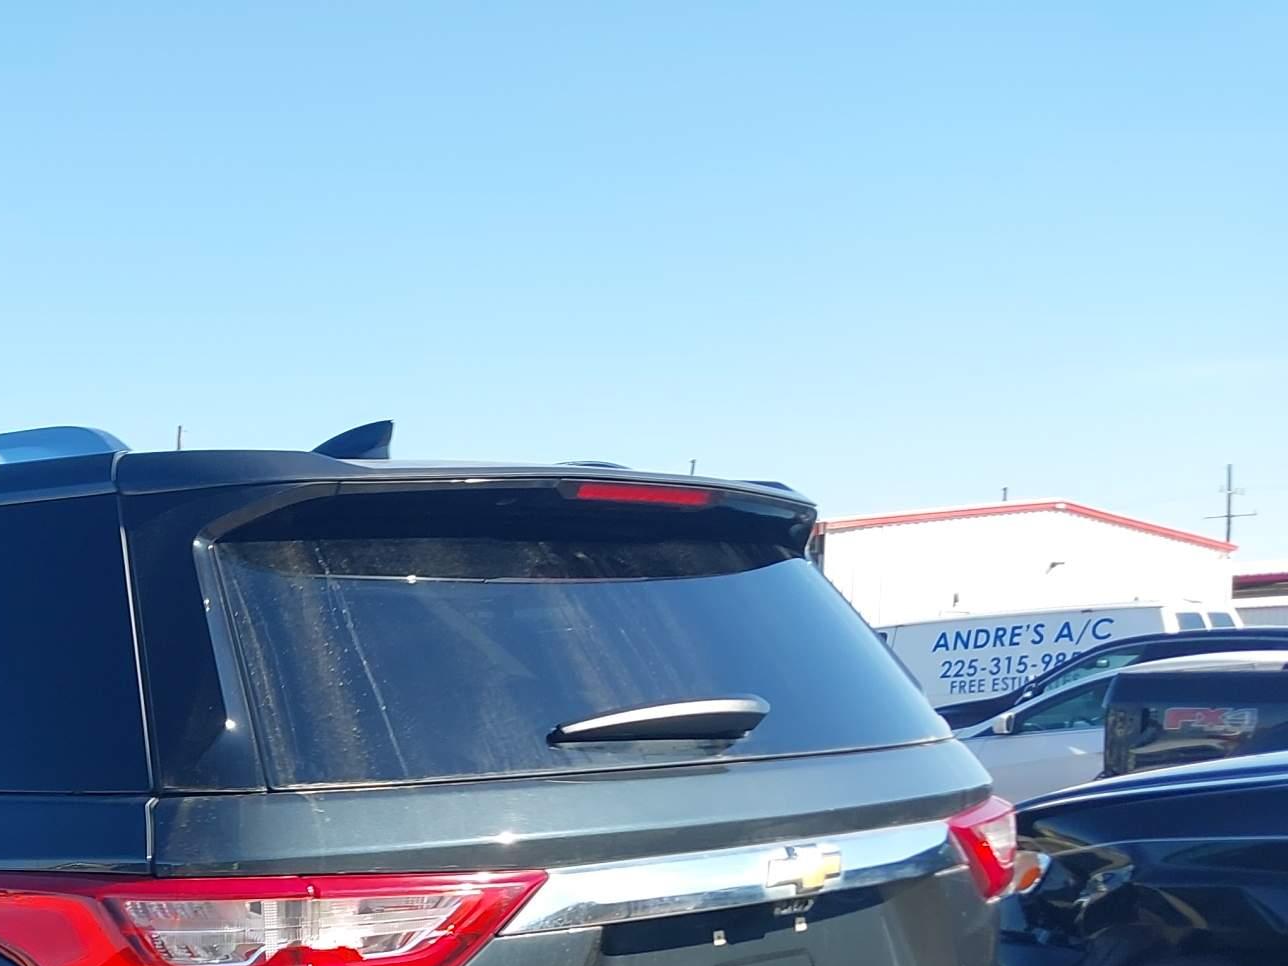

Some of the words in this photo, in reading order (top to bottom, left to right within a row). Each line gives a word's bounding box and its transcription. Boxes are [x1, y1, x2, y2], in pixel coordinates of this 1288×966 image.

[932, 623, 1045, 653] ANDRE'S
[1054, 618, 1115, 645] A/C
[940, 651, 1082, 679] 225-315-98
[949, 678, 986, 695] FREE
